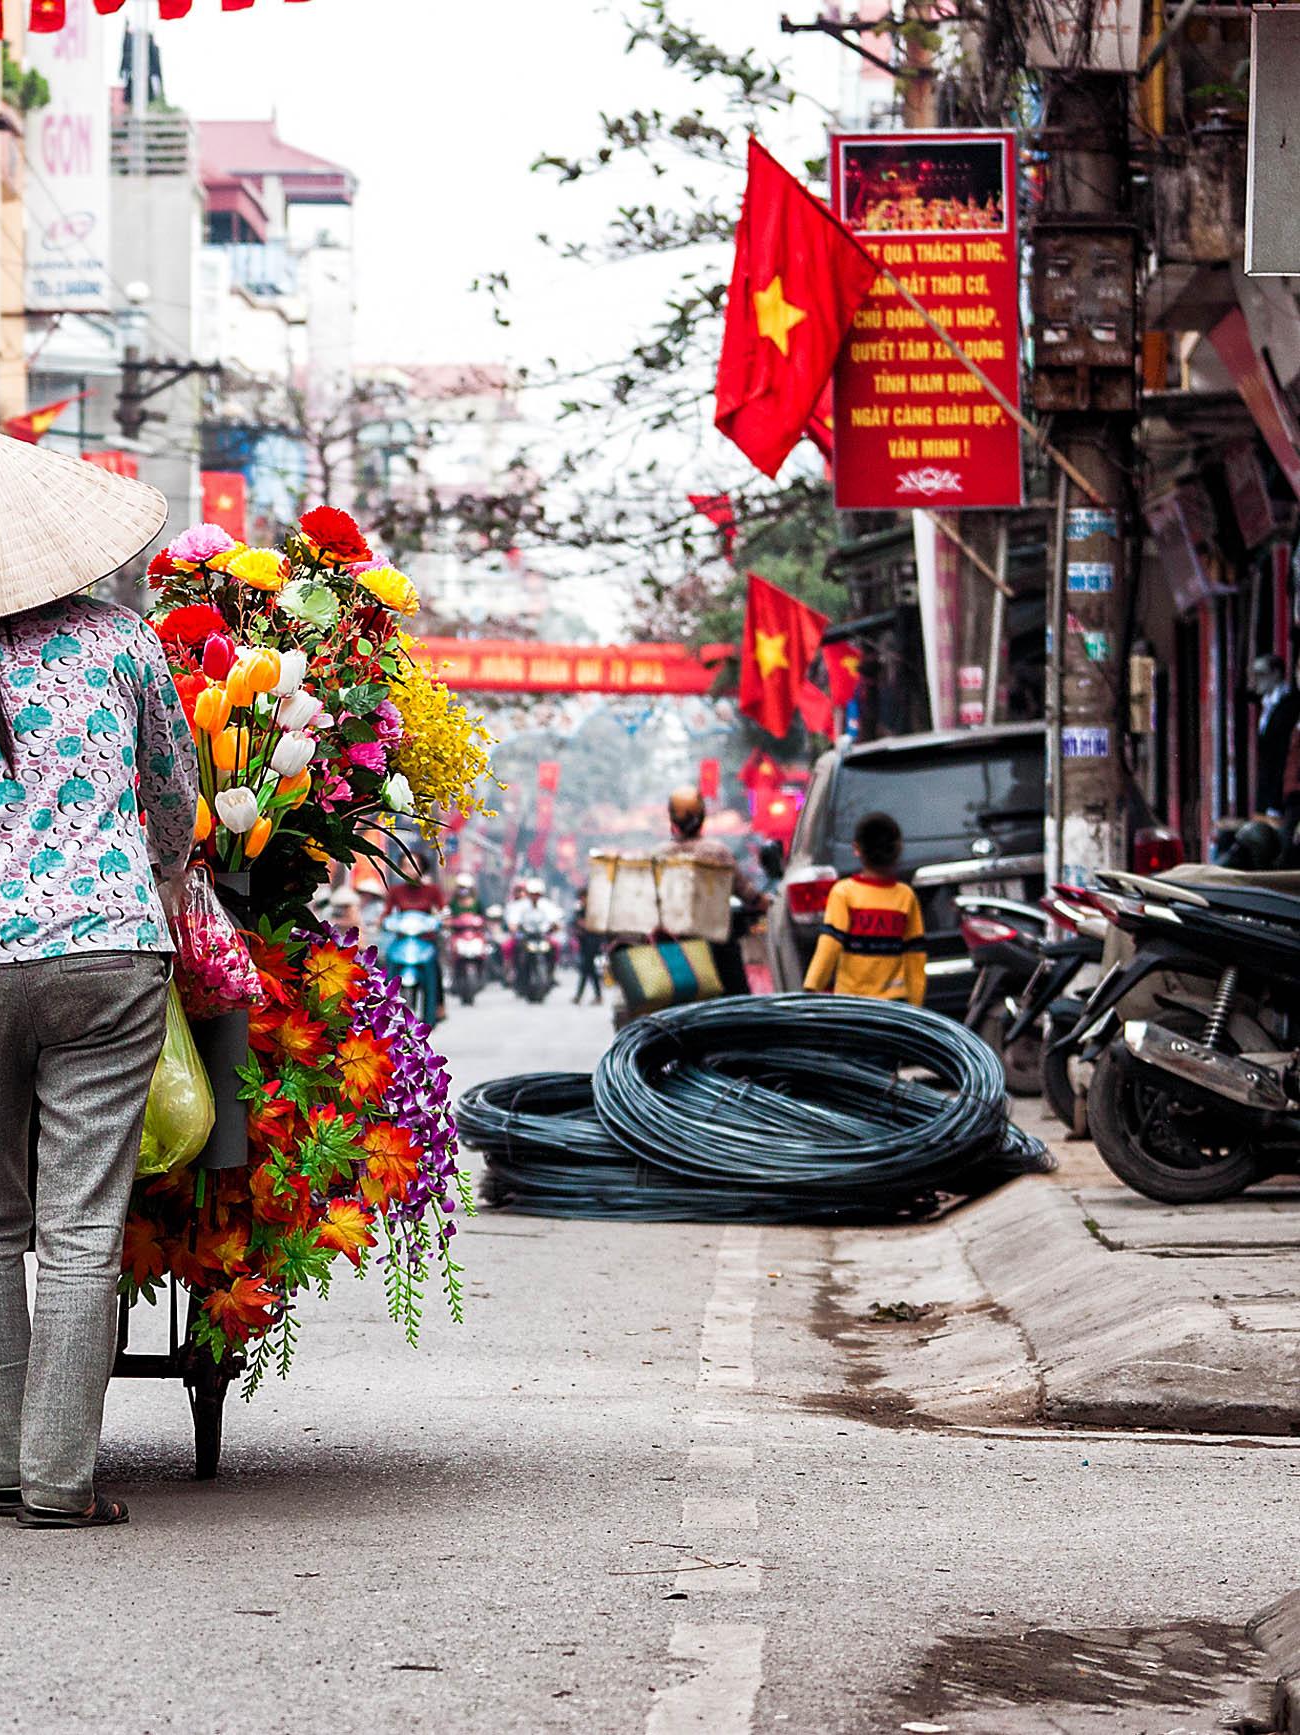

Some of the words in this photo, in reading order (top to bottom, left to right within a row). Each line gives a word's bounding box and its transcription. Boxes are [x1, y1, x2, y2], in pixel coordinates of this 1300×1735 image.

[883, 243, 913, 265] QUA
[916, 240, 963, 264] THÁCH
[873, 368, 907, 394] TỈNH
[910, 373, 944, 393] NAM
[851, 404, 890, 427] NGÀY
[893, 403, 933, 427] CÀNG
[936, 402, 970, 426] GIÀU
[920, 438, 961, 459] MINH
